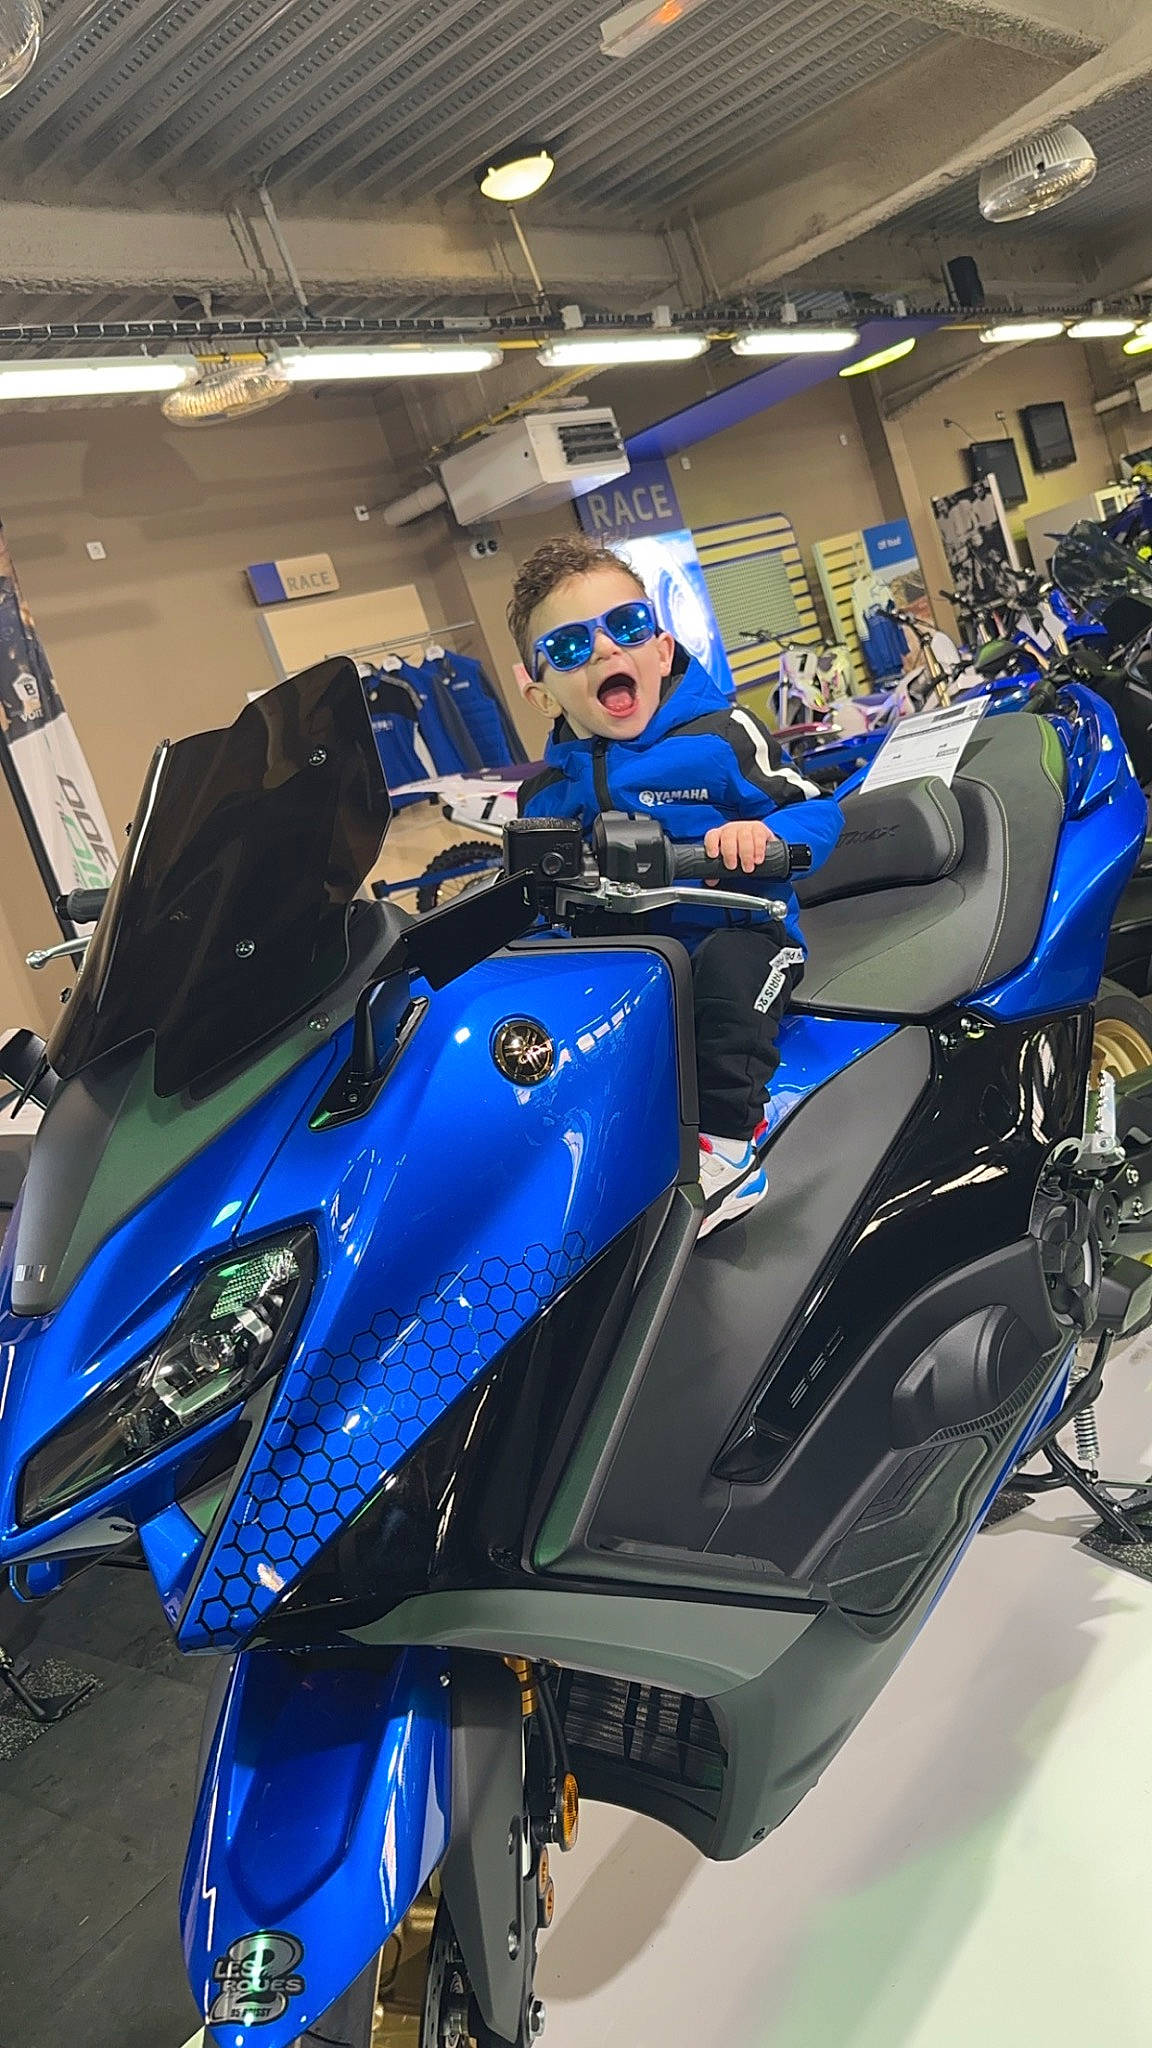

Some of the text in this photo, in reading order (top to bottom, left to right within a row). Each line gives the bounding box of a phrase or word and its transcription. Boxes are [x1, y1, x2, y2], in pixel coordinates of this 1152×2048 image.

[587, 485, 672, 529] RACE
[287, 571, 331, 592] RACE
[655, 788, 709, 801] YAMAHA
[214, 1960, 256, 1979] LES
[222, 1977, 303, 1994] ROUES
